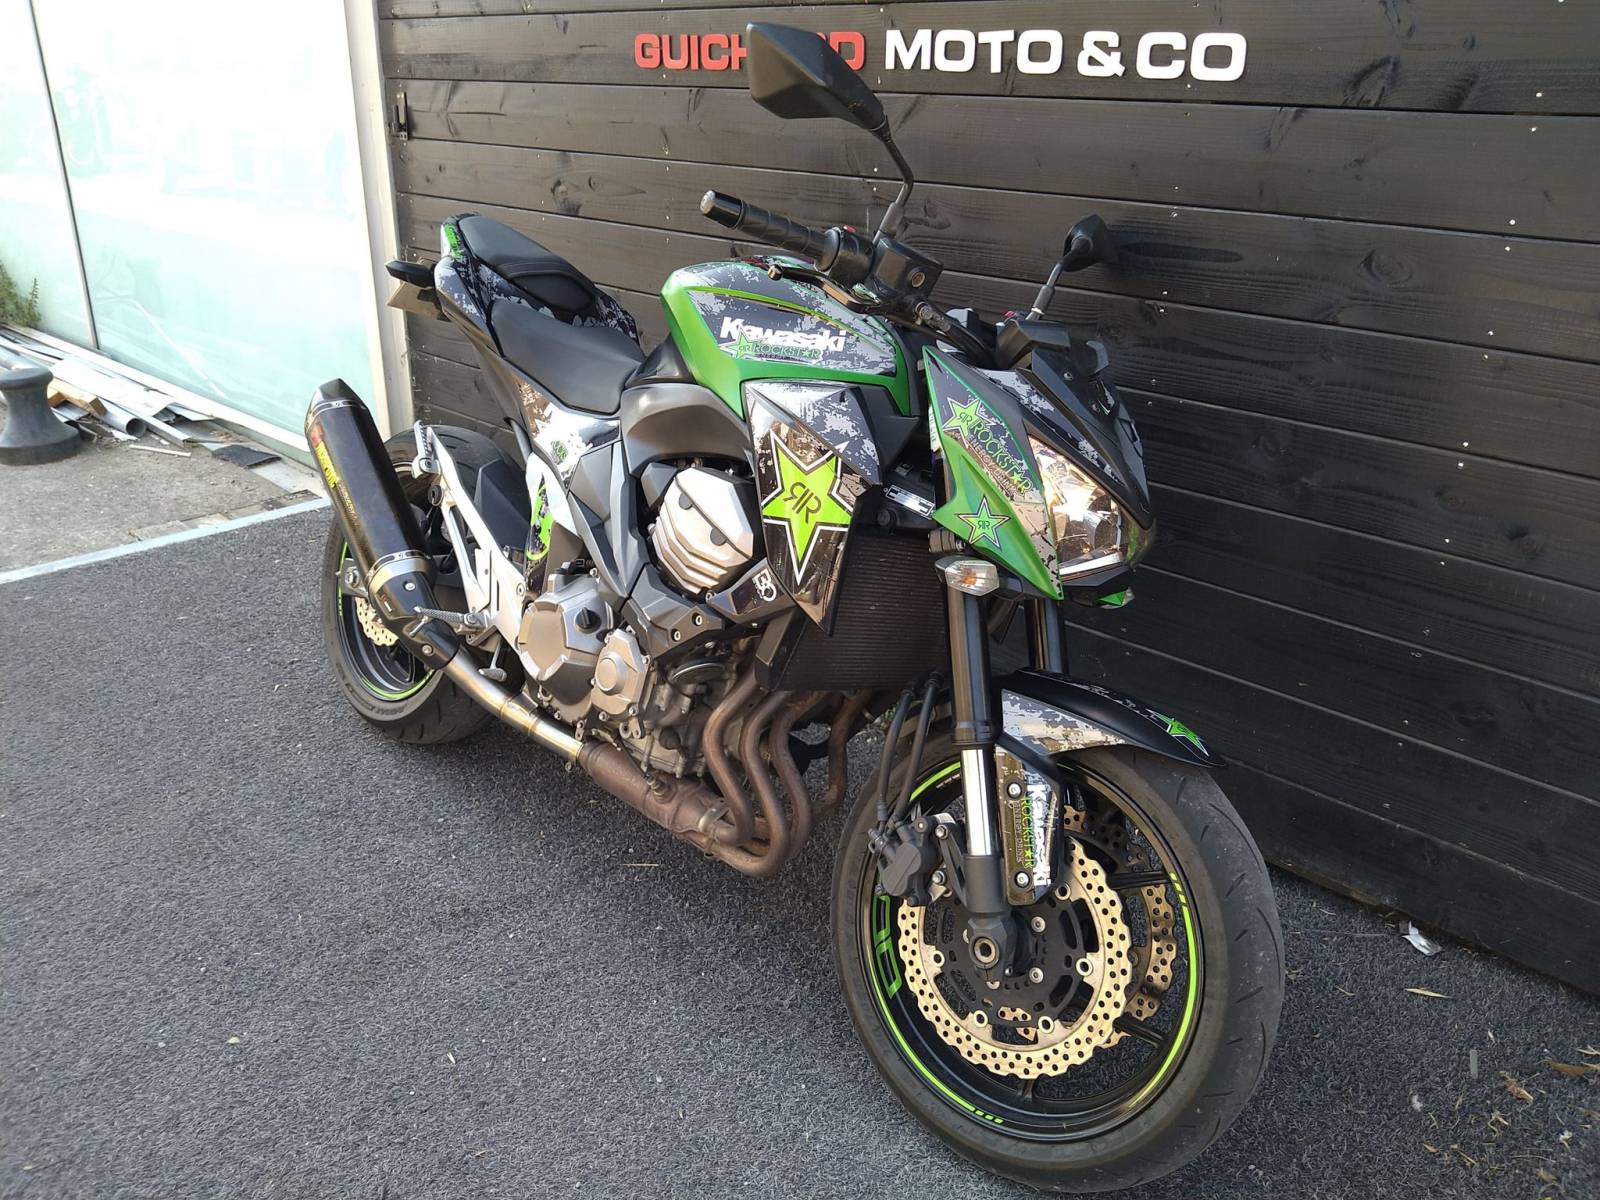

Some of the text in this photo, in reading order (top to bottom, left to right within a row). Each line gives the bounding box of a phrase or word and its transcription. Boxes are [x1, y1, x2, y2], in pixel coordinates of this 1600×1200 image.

[634, 31, 865, 71] GUICHD
[885, 28, 1063, 75] MOTO
[719, 316, 846, 352] Kawasaki
